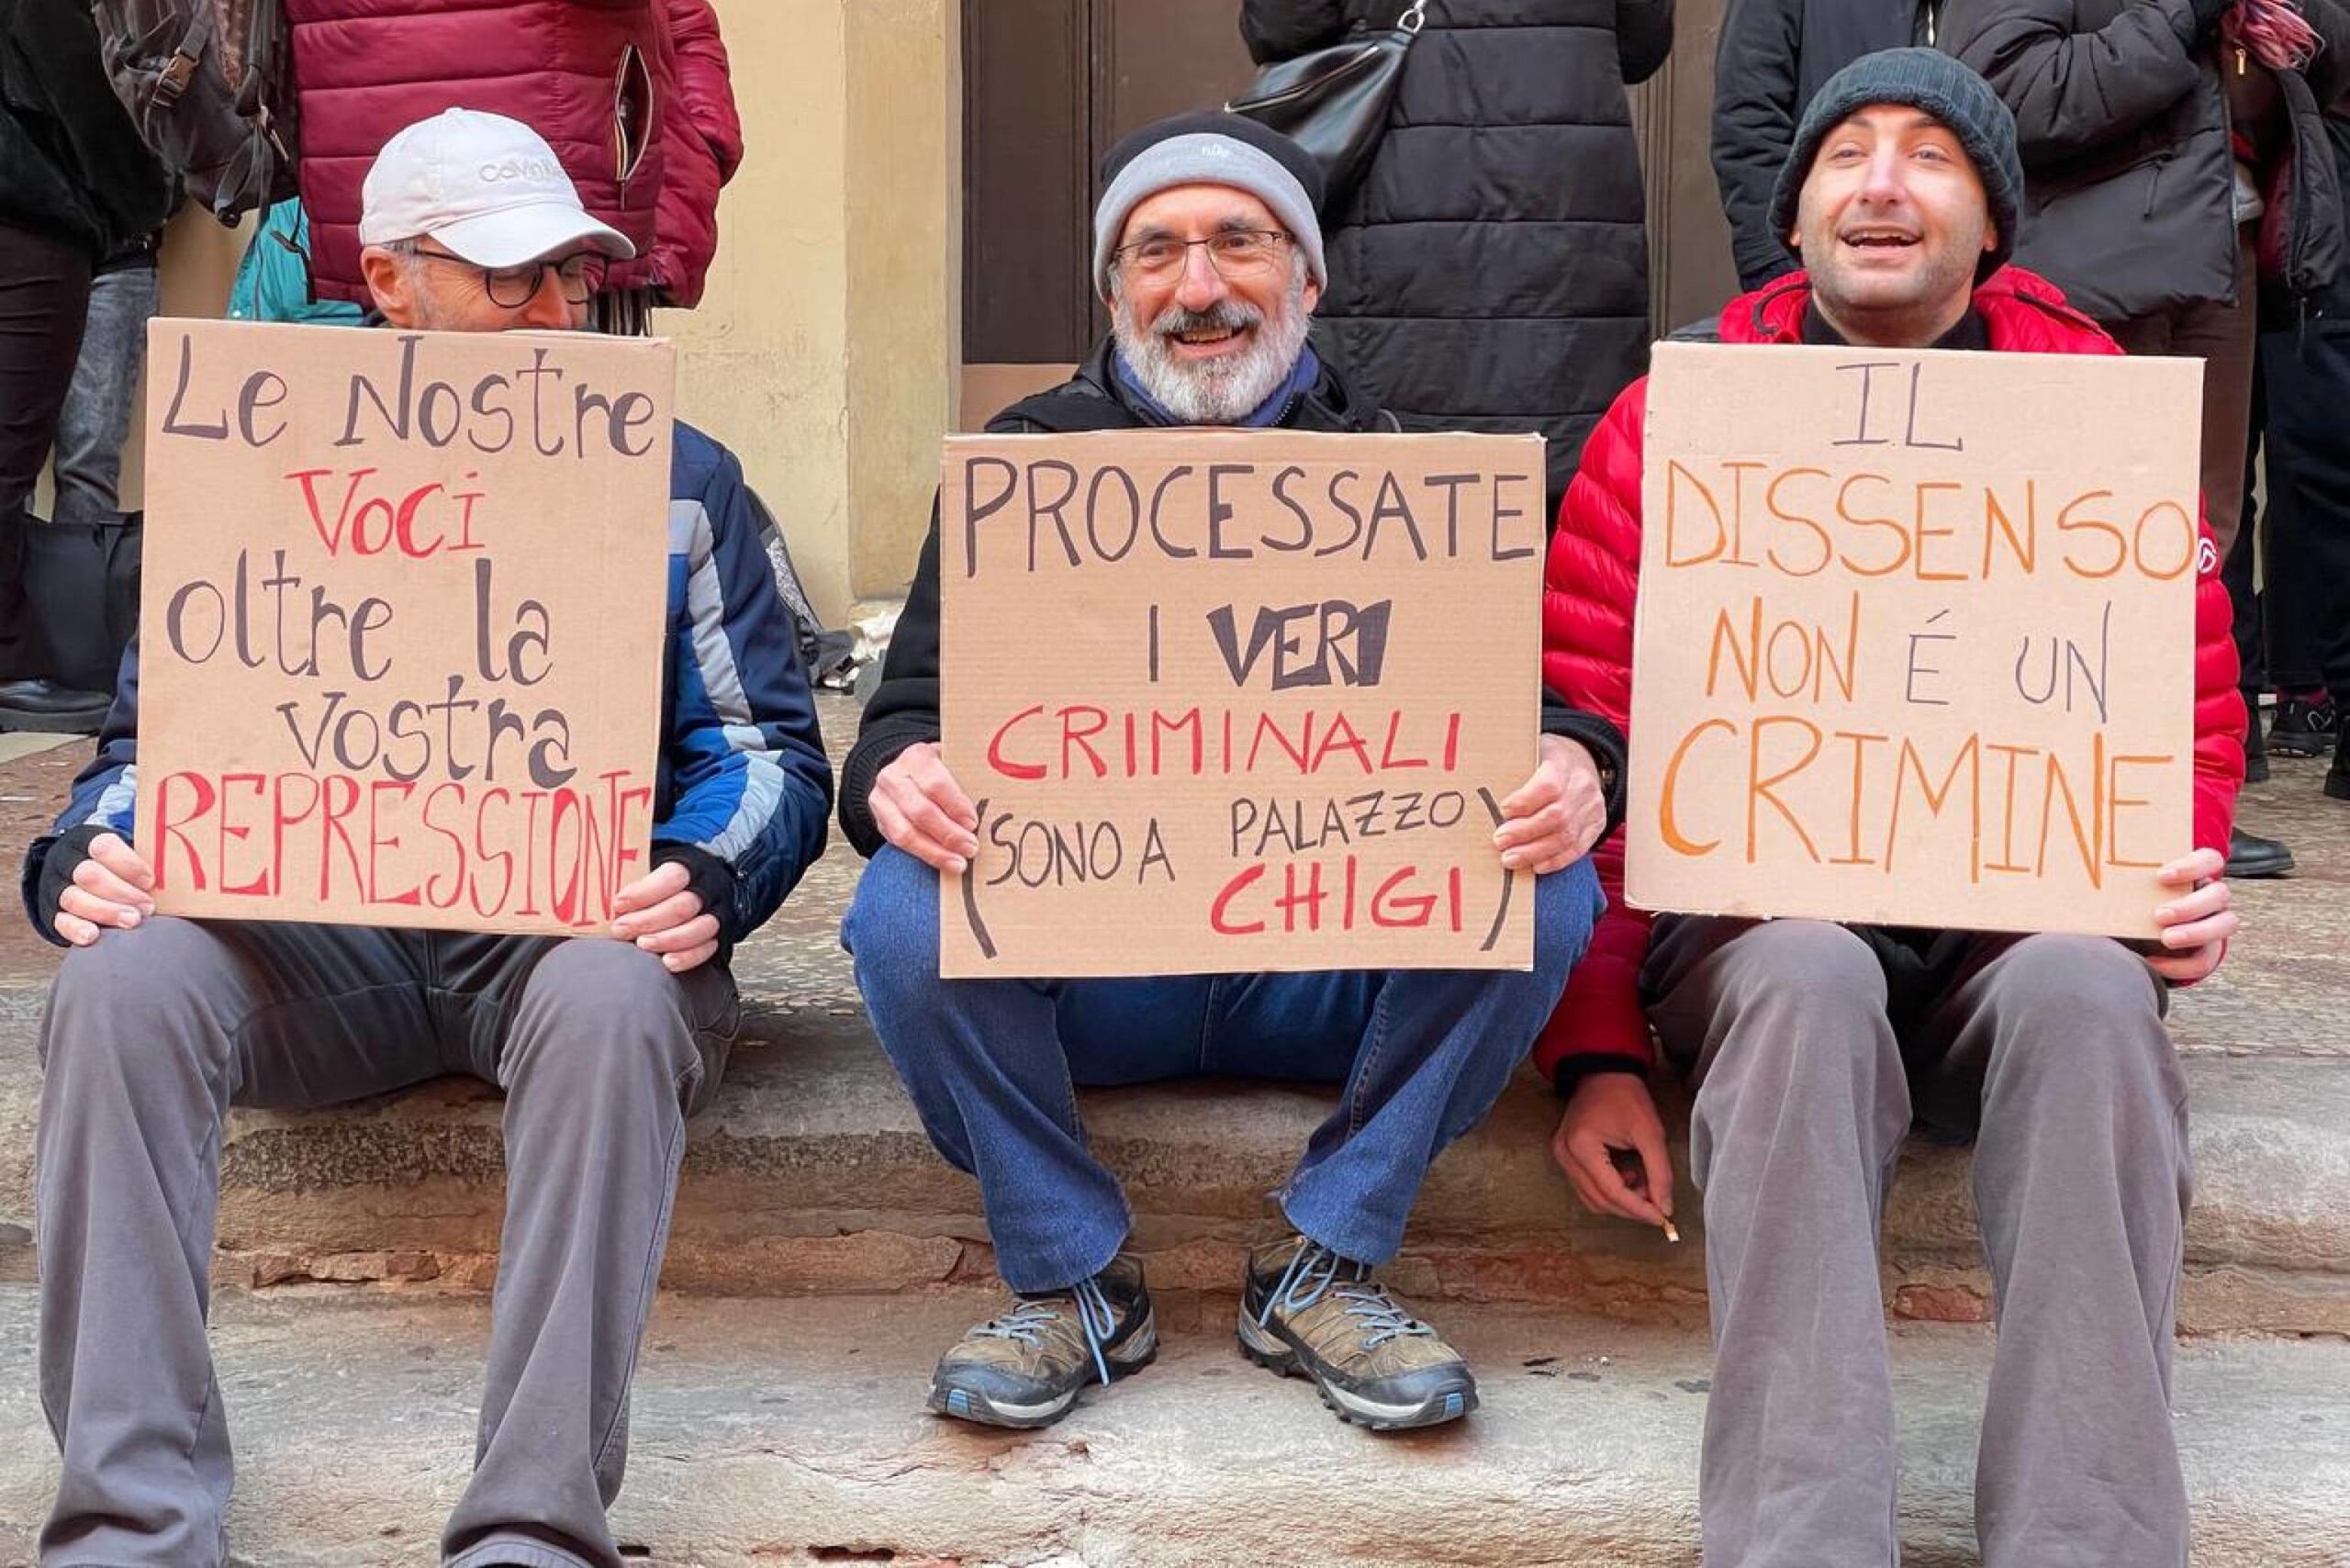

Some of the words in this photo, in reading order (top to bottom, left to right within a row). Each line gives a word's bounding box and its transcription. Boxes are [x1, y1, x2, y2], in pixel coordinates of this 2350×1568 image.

[162, 333, 287, 447] Le
[333, 335, 655, 458] Nostre
[1832, 363, 1963, 451] IL
[965, 457, 1536, 578] PROCESSATE
[1665, 460, 2194, 581] DISSENSO
[166, 549, 393, 681] oltre
[476, 557, 554, 686] la
[1148, 603, 1158, 682] I
[1206, 599, 1393, 690] VERI
[1706, 590, 1860, 703] NON
[1906, 608, 1957, 706] É
[2015, 599, 2112, 724] UN
[276, 675, 577, 790] vostra
[986, 705, 1461, 779] CRIMINALI
[153, 769, 653, 927] REPRESSIONE
[1138, 818, 1176, 885] A
[1230, 790, 1465, 858] PALAZZO
[1659, 715, 2175, 890] CRIMINE
